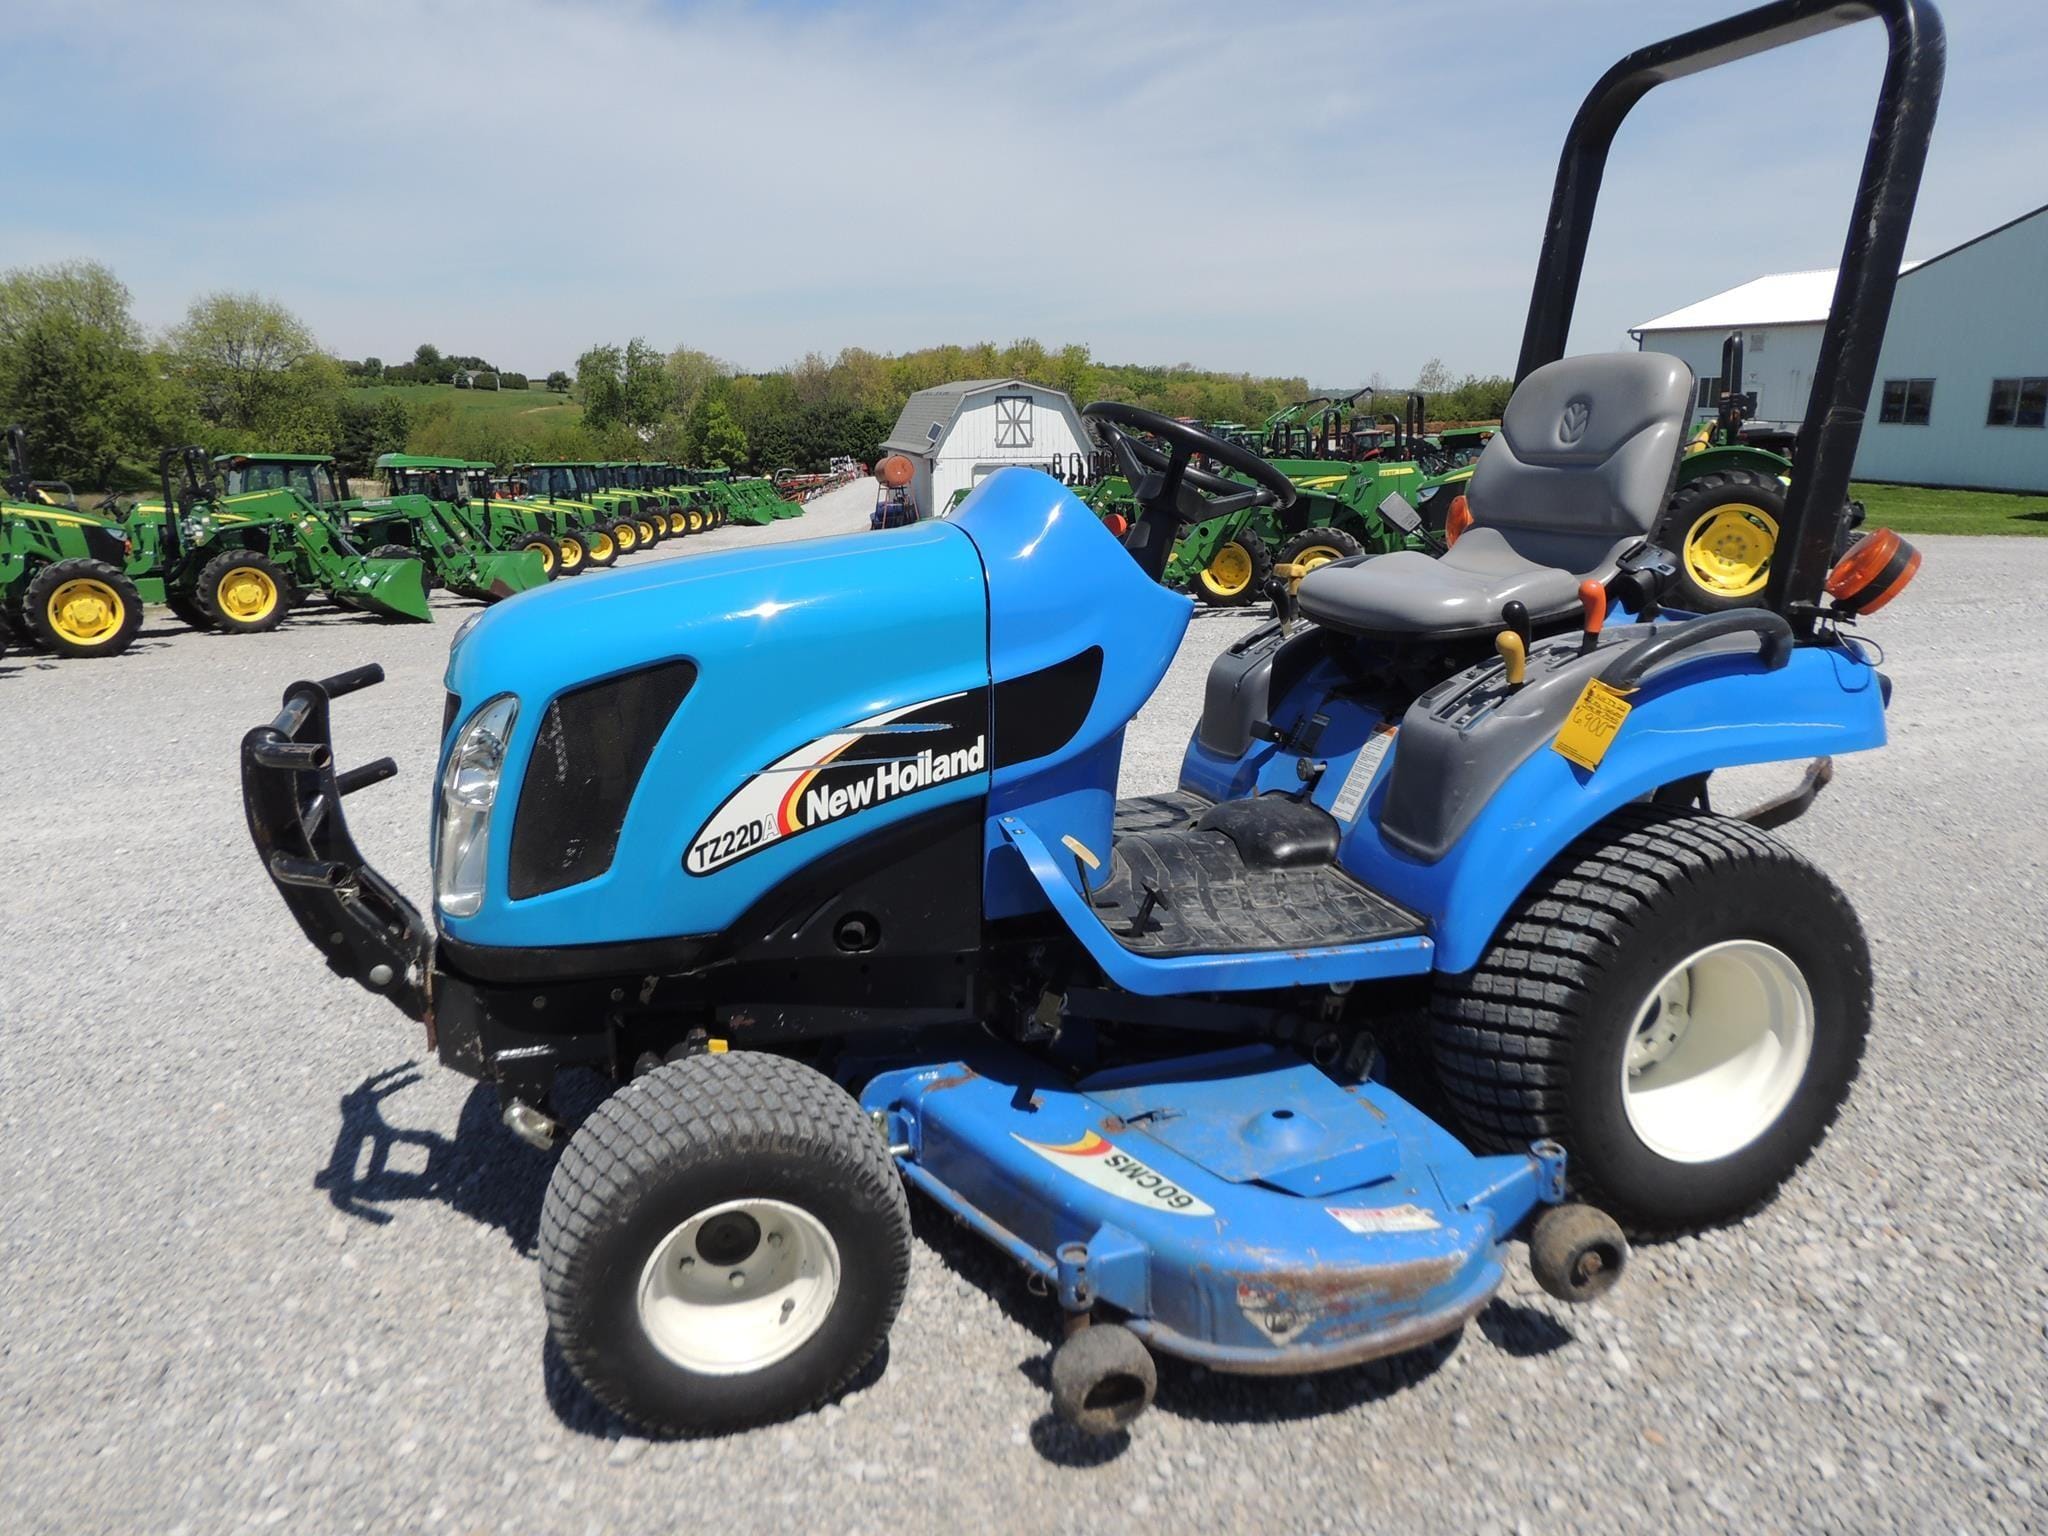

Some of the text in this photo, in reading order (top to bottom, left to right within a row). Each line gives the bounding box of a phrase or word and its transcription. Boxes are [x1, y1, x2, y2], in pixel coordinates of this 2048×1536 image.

[806, 734, 985, 827] New Holland
[693, 813, 781, 869] TZ22DA
[1103, 1153, 1194, 1209] 60CMS
